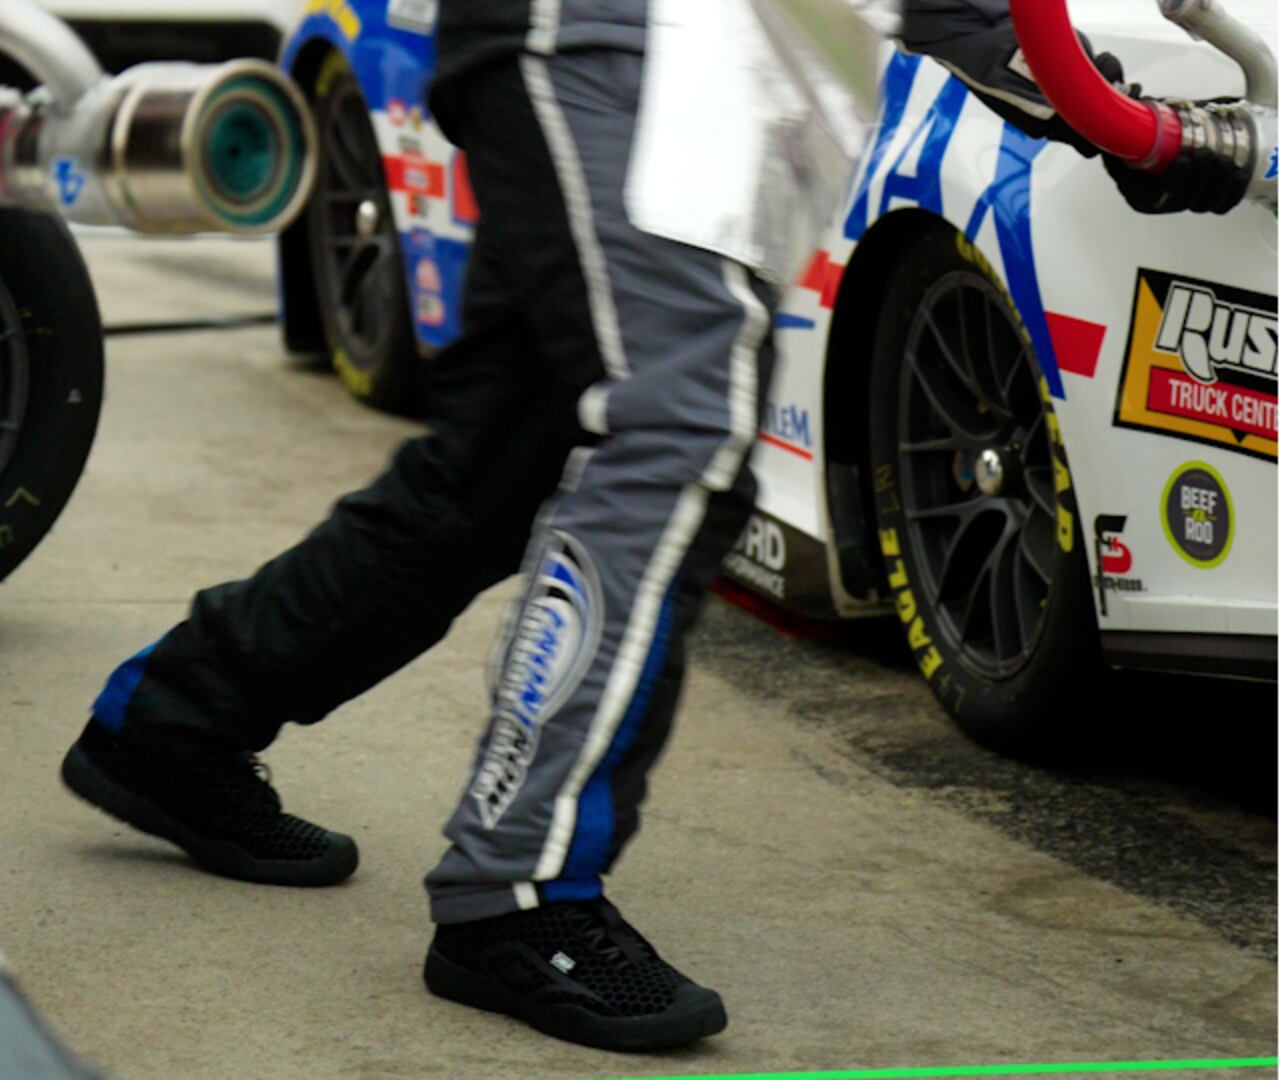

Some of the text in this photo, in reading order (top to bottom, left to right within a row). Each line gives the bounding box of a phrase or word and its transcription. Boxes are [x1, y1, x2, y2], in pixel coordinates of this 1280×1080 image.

[1154, 282, 1278, 383] Rus
[1169, 378, 1229, 419] TRUCK
[1180, 484, 1218, 514] BEEF
[1185, 515, 1214, 545] ROO
[879, 528, 943, 679] EAGLE
